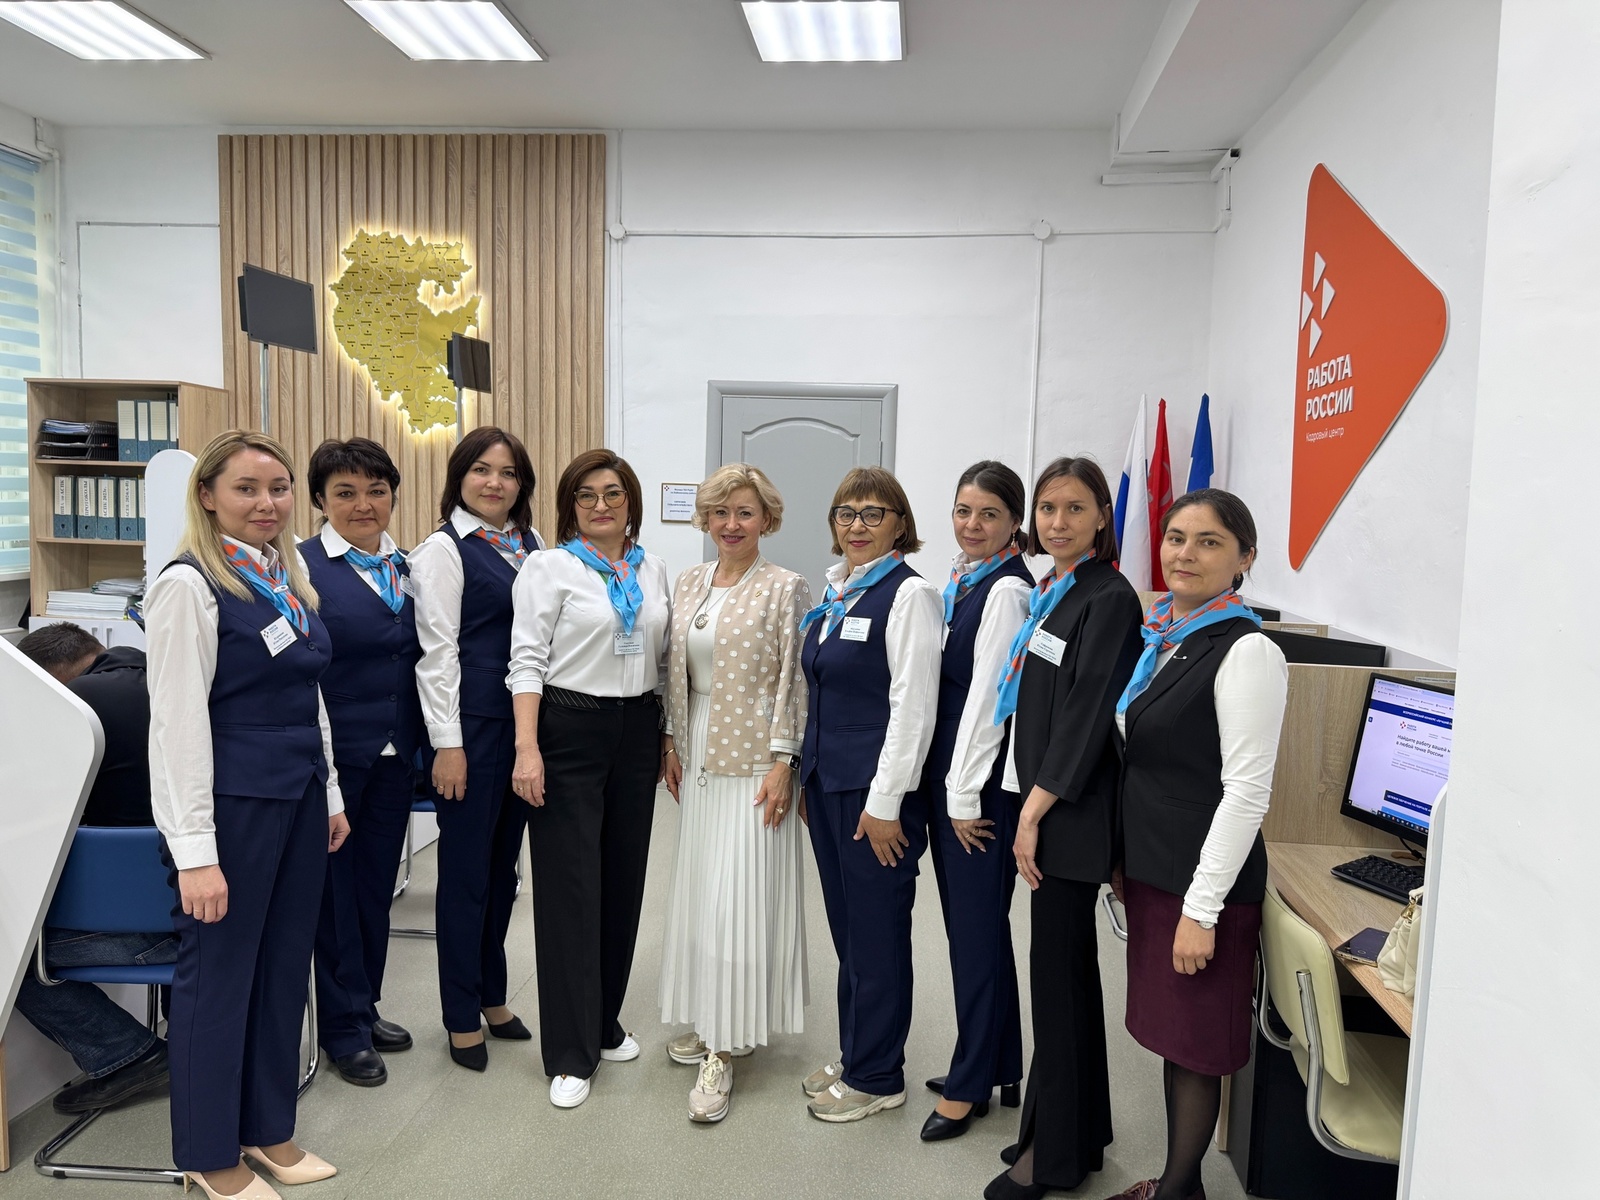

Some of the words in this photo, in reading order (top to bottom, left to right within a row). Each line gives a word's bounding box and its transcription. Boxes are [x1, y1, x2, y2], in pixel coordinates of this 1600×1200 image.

[1306, 354, 1352, 391] РАБОТА
[1305, 386, 1353, 422] РОССИИ
[1305, 428, 1329, 443] Кадровый
[1329, 426, 1345, 438] центр
[1397, 735, 1416, 744] Найдите
[1416, 740, 1431, 749] работу
[1431, 744, 1447, 752] вашей
[1399, 741, 1414, 749] любой
[1427, 749, 1444, 758] России
